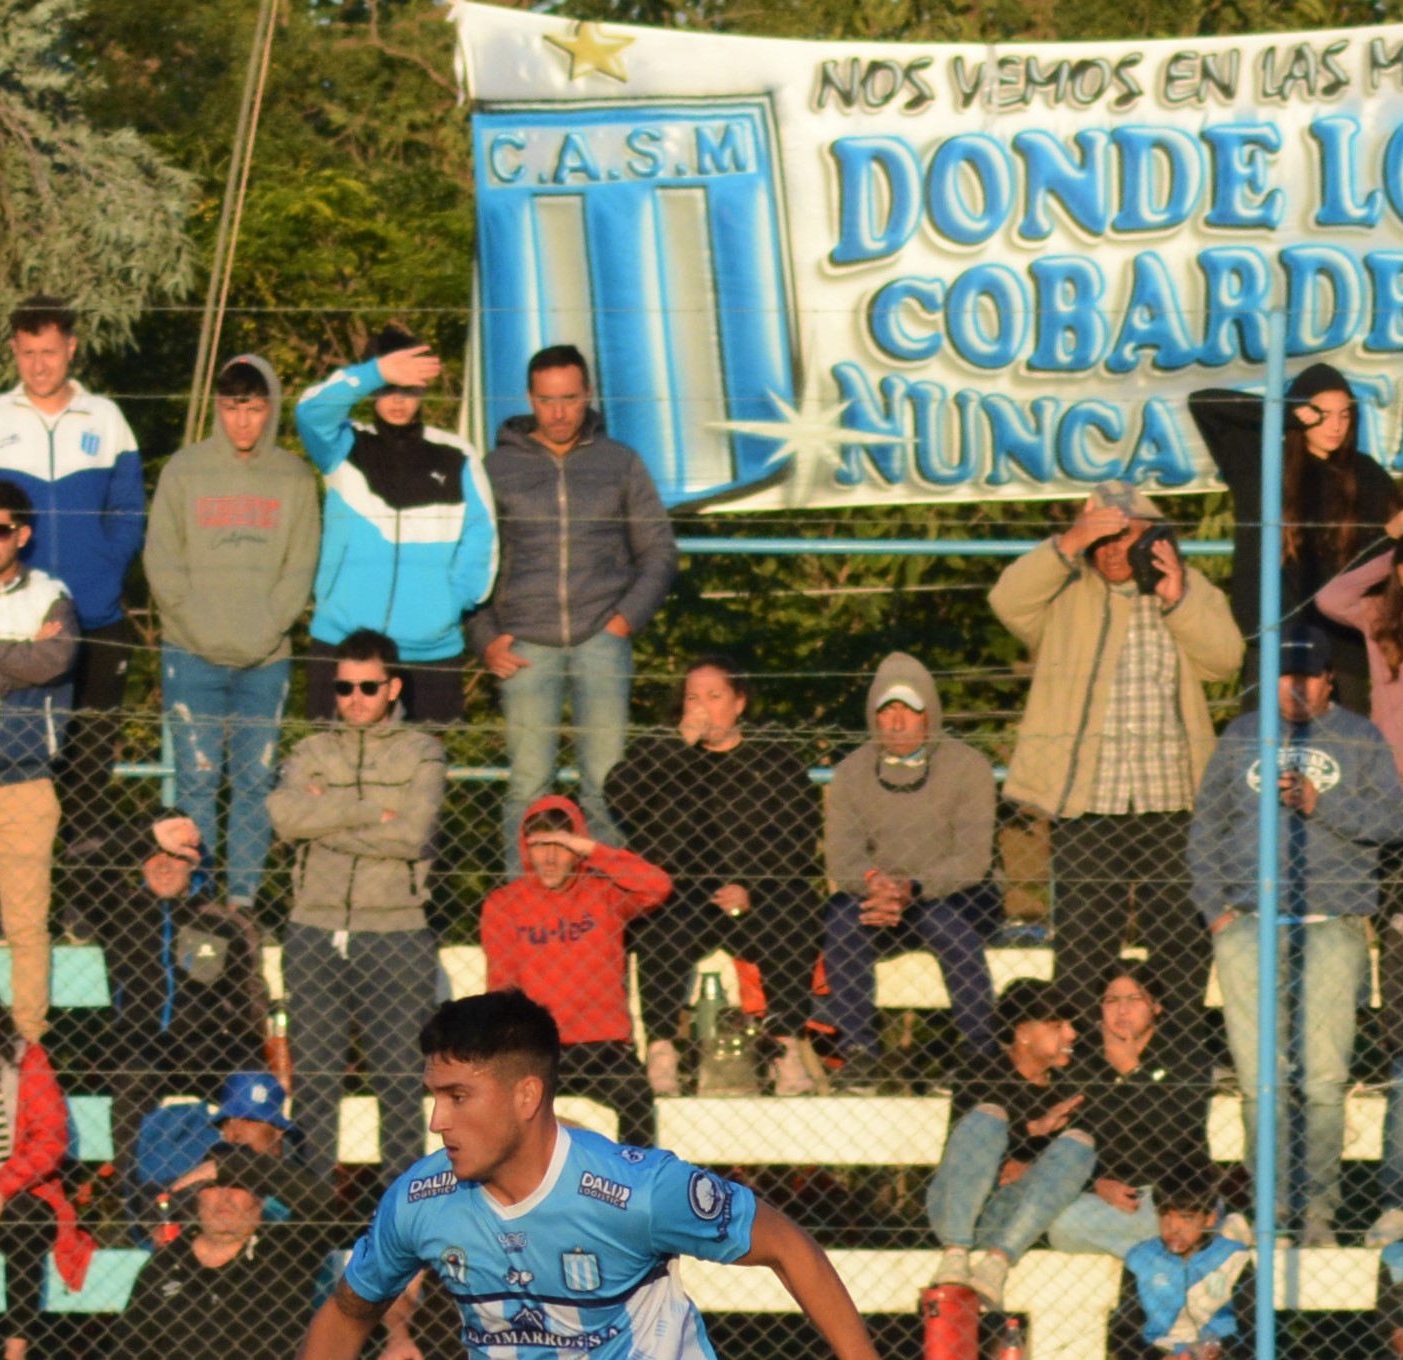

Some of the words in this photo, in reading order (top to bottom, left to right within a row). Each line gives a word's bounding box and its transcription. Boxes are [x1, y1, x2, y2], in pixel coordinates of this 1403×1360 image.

[815, 57, 935, 111] NOS
[952, 51, 1143, 106] VEMOS
[1162, 48, 1238, 101] EN
[1262, 38, 1351, 99] LAS
[828, 118, 1285, 267] DONDE
[833, 361, 1198, 489] NUNCA
[579, 1186, 627, 1209] LOGISTICA
